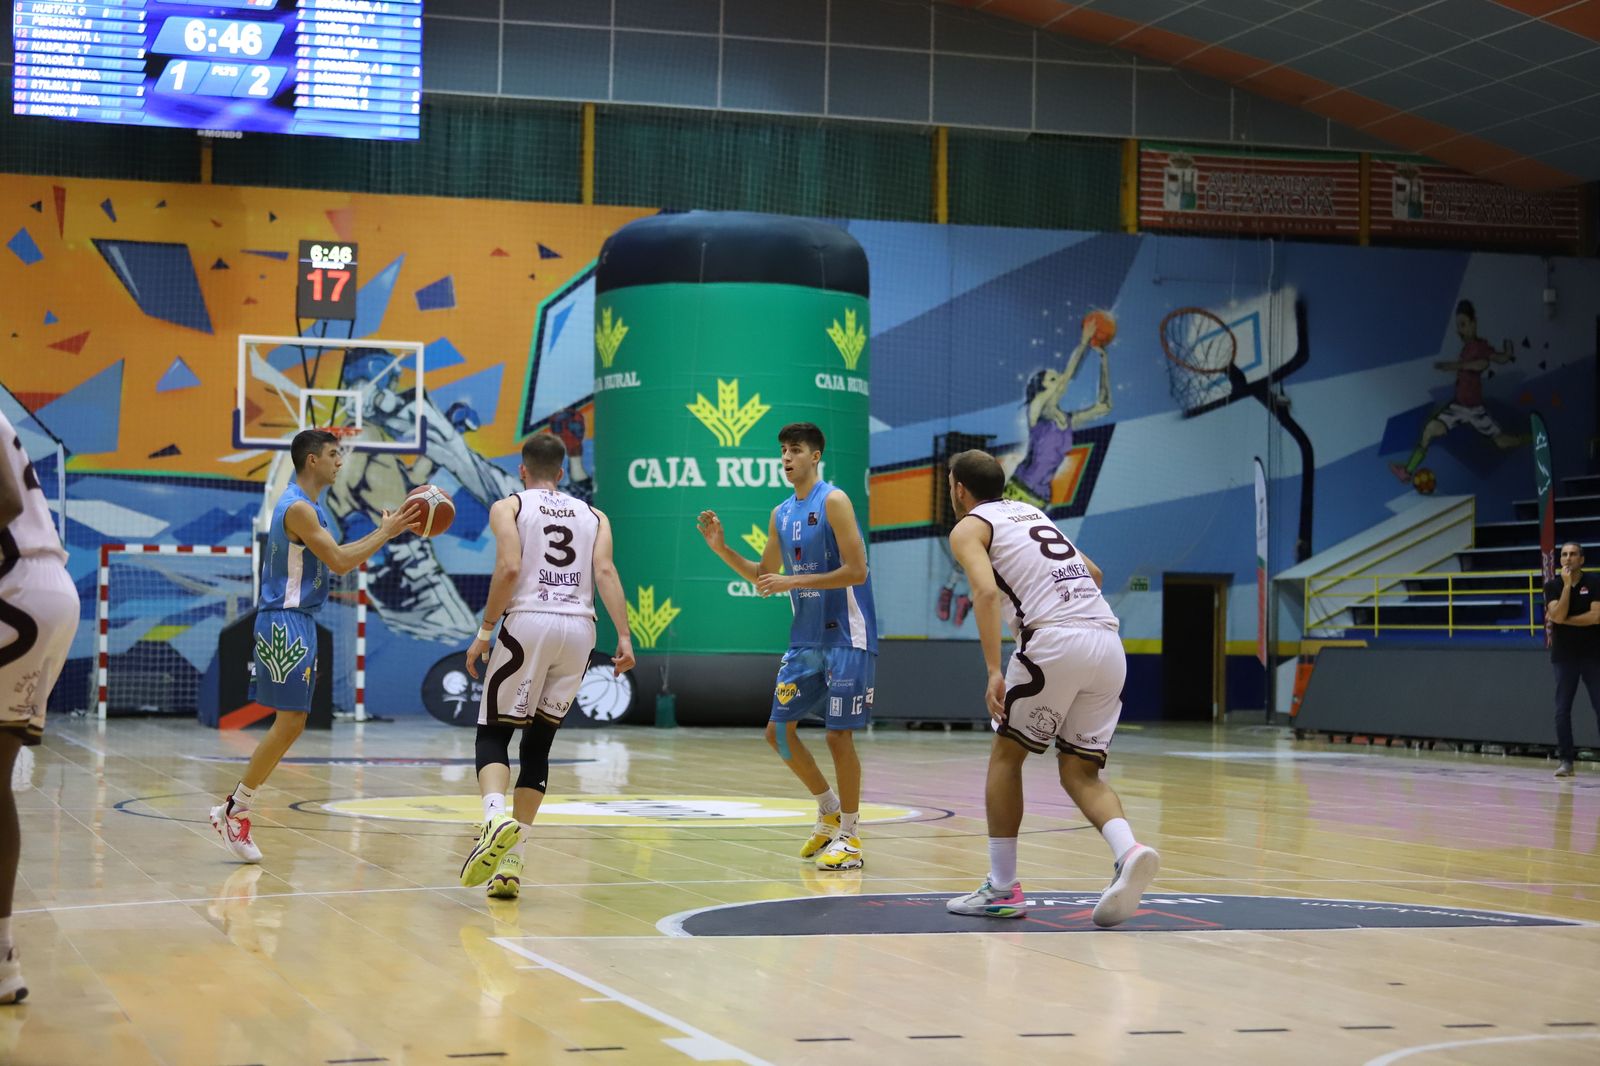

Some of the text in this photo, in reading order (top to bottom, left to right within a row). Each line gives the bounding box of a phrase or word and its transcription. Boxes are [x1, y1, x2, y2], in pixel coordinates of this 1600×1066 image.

[184, 19, 262, 56] 6:46
[170, 61, 270, 96] 1 2
[1239, 191, 1334, 216] ZAMORA
[310, 244, 352, 264] 6:46
[306, 269, 351, 302] 17
[604, 371, 641, 390] RURAL
[815, 373, 845, 391] CAJA
[628, 457, 706, 488] CAJA
[792, 521, 801, 541] 12
[1029, 525, 1076, 561] 8
[543, 524, 576, 568] 3
[539, 569, 581, 583] SALINERO
[1051, 563, 1090, 579] SALINER
